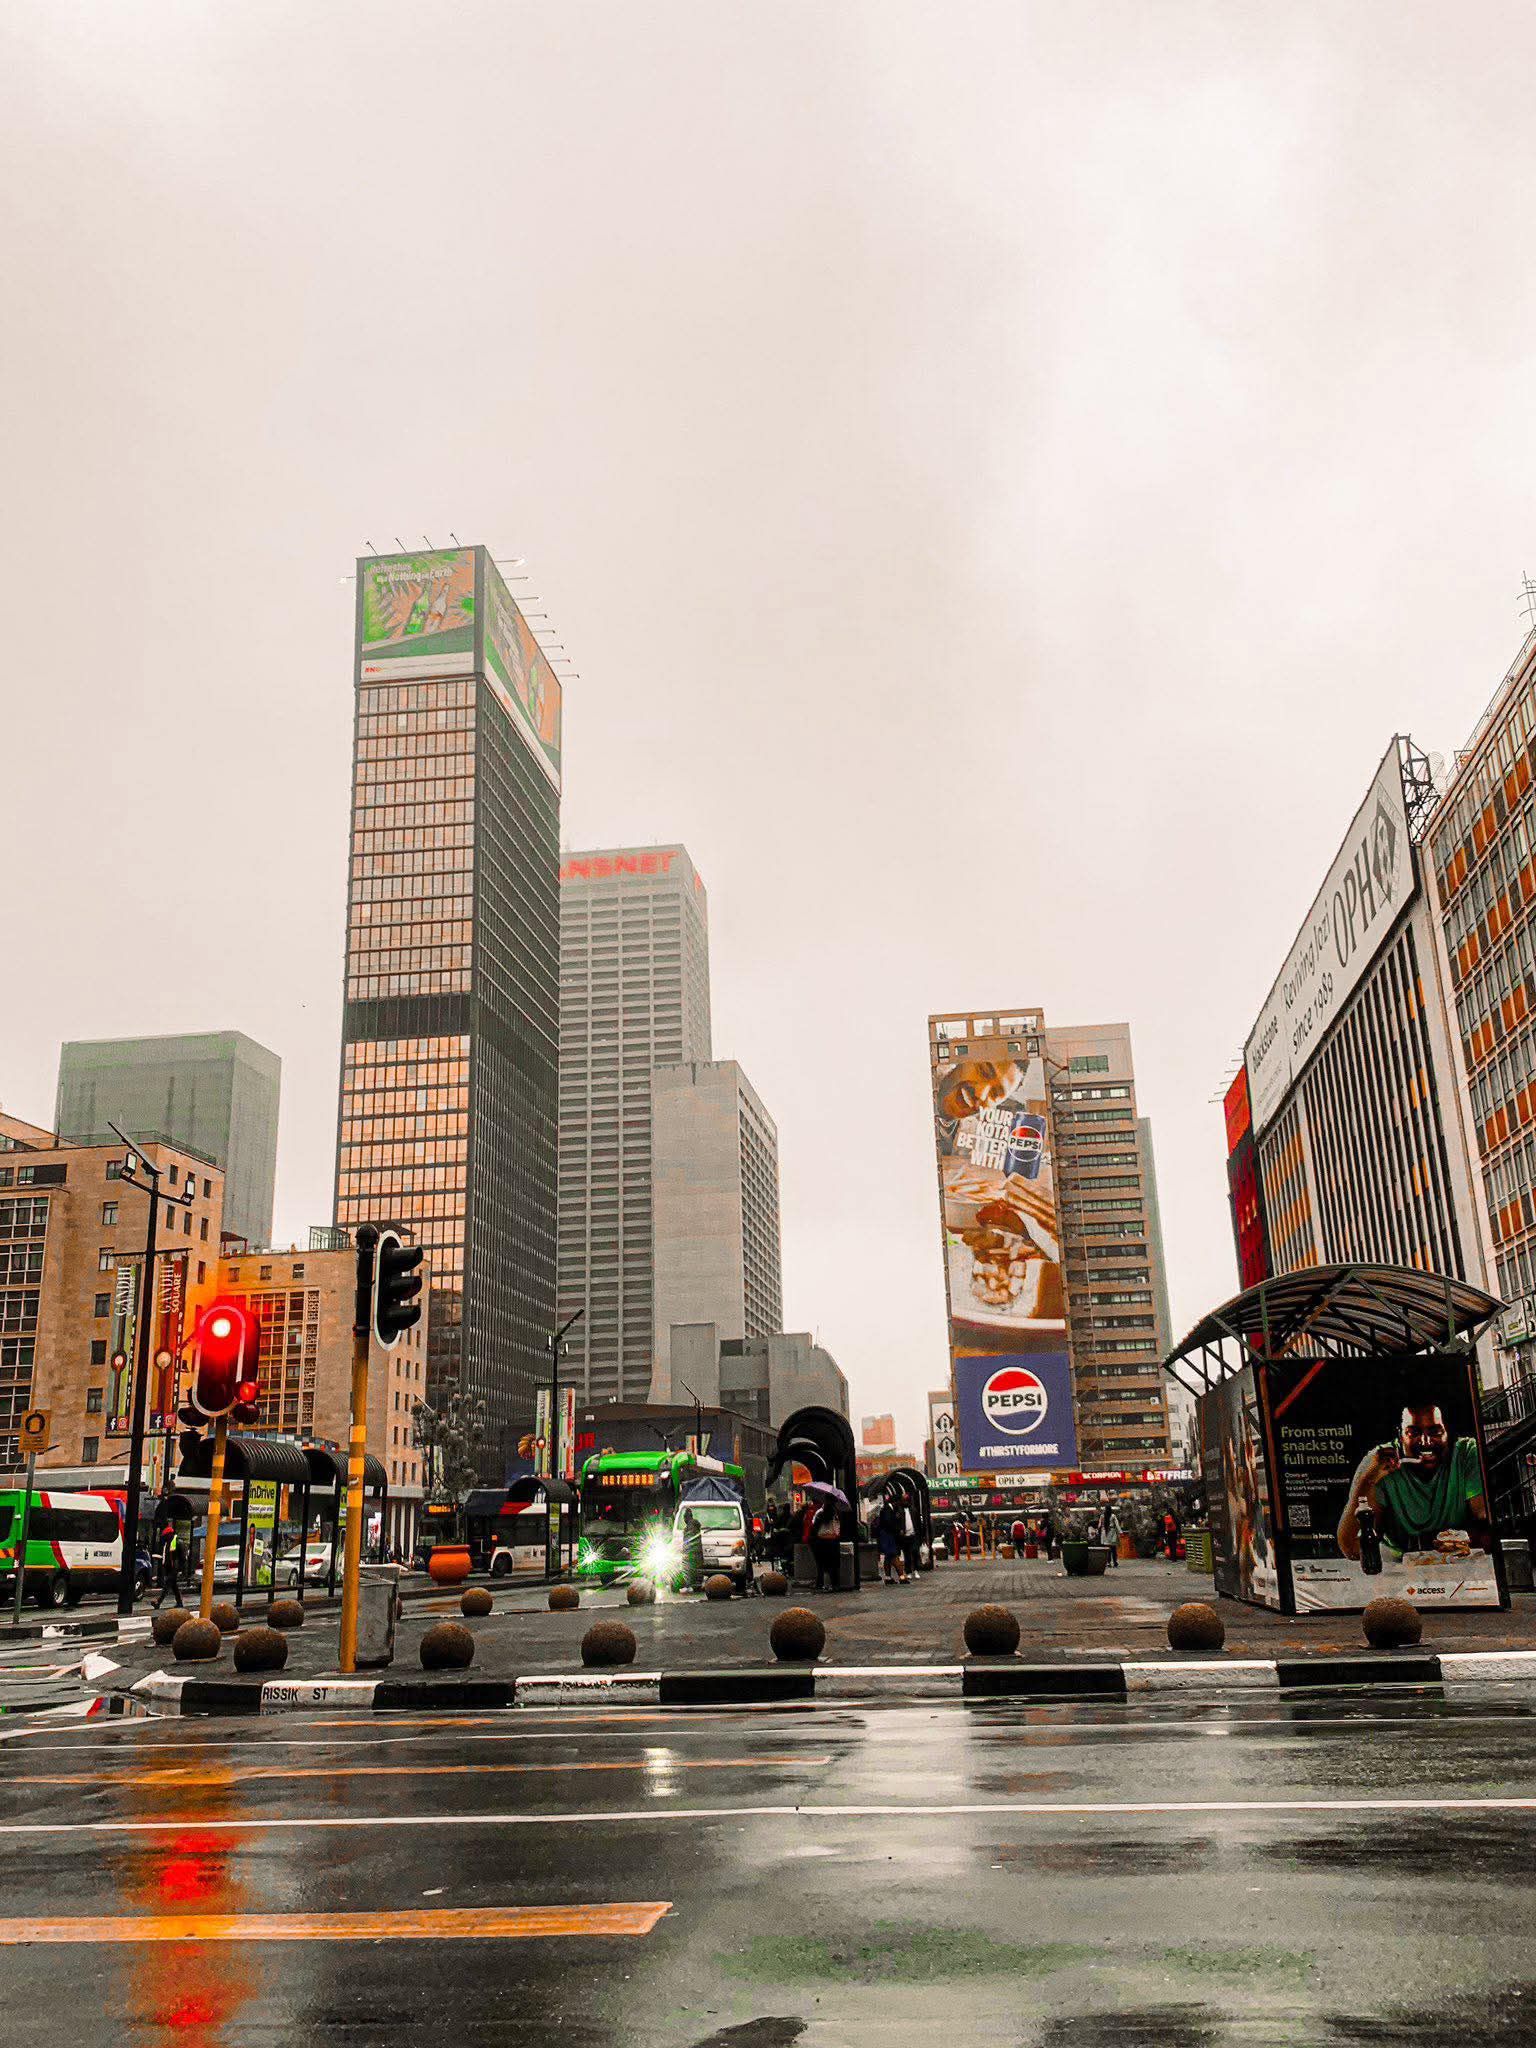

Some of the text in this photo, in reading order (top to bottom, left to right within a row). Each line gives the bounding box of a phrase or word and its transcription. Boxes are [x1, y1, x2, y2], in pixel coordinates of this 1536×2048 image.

[1333, 836, 1376, 968] OPH
[1283, 940, 1316, 1012] Reviving
[1292, 971, 1334, 1055] since 1989
[979, 1105, 1014, 1126] YOUR
[976, 1121, 1010, 1140] KOTA
[957, 1132, 1008, 1155] BETTER
[1009, 1137, 1041, 1150] PEPSI
[971, 1150, 1006, 1170] WITH
[115, 1266, 132, 1317] GANDHI
[159, 1264, 175, 1314] GANDHI
[171, 1272, 183, 1314] SQUARE
[987, 1393, 1042, 1408] PEPSI
[1281, 1424, 1353, 1438] From small
[979, 1443, 1059, 1457] #THIRSTYFORMORE
[1282, 1440, 1344, 1452] snacks to
[1283, 1453, 1350, 1465] full meals.
[250, 1482, 275, 1499] inDrive
[927, 1478, 968, 1489] Dis-Chem
[1417, 1586, 1446, 1595] access
[263, 1687, 329, 1701] RISSIK ST
